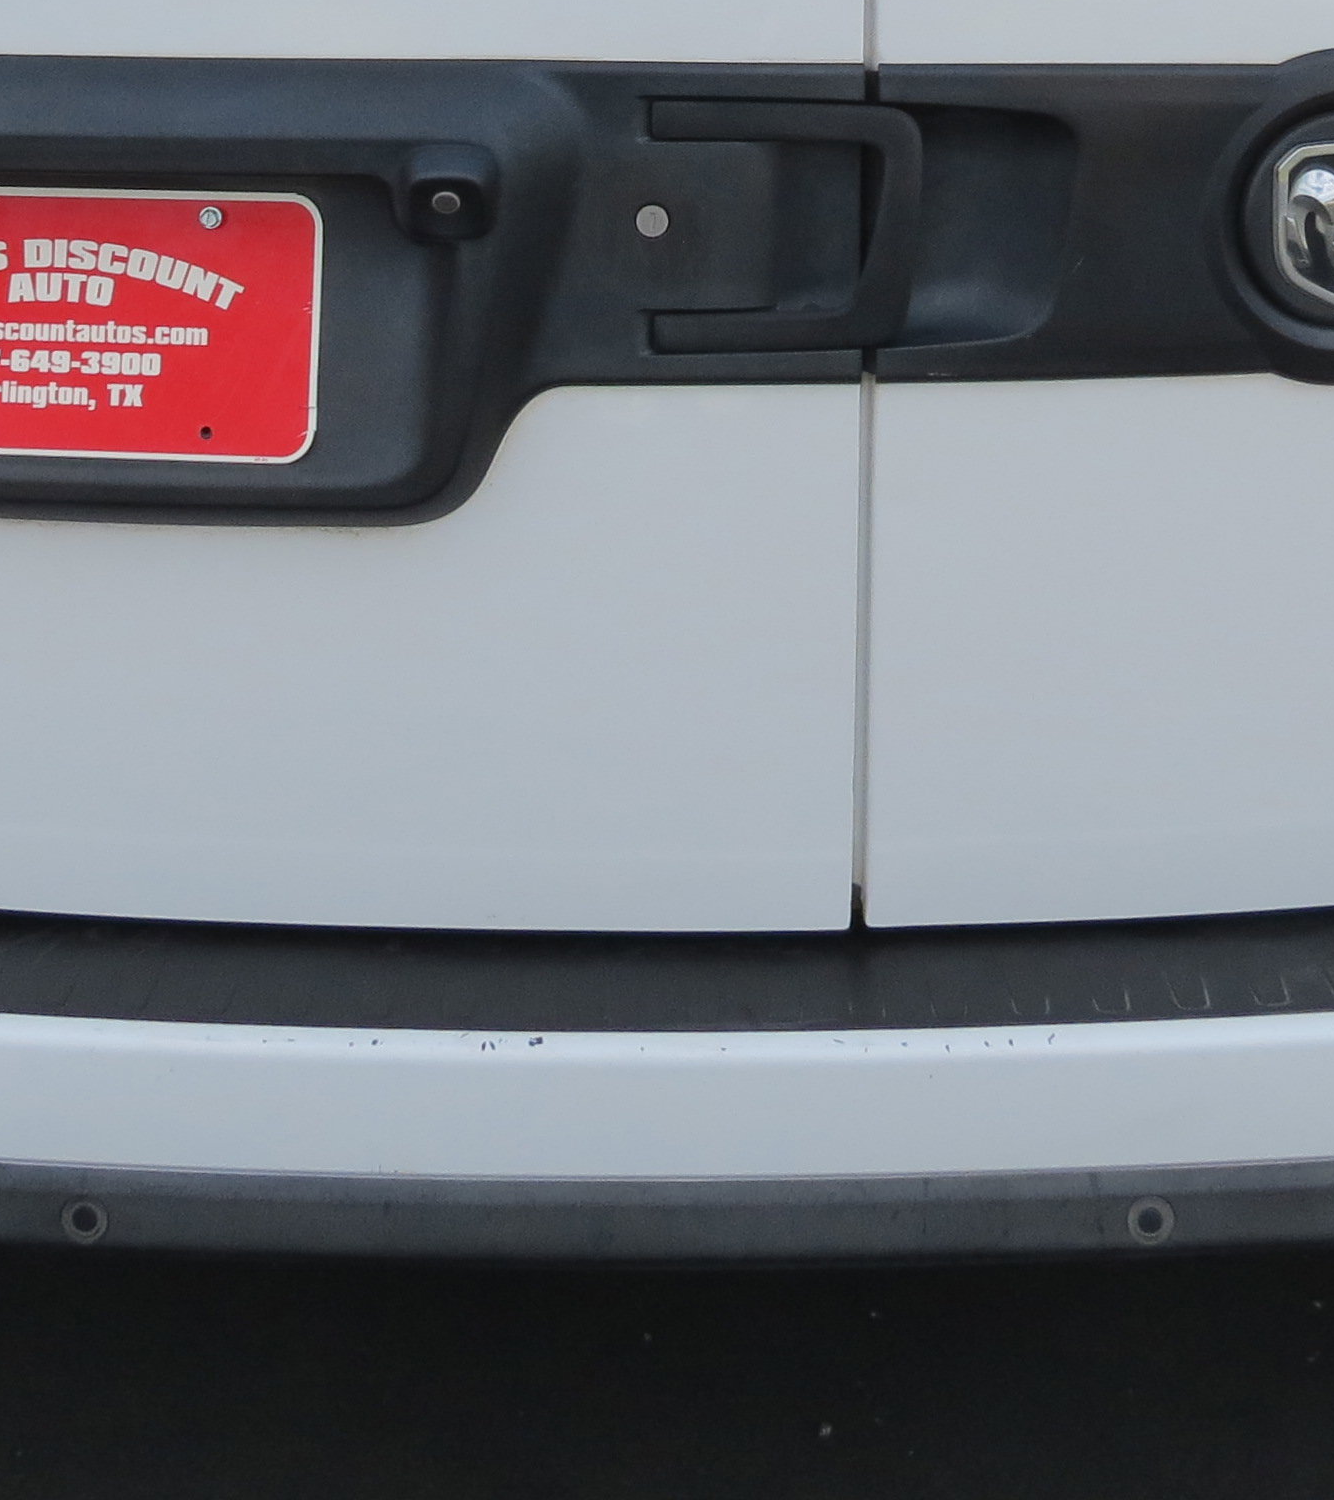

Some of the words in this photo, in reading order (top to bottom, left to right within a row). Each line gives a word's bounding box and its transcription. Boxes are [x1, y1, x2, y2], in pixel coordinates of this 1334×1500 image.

[8, 273, 115, 307] AUTO
[23, 238, 245, 311] DISCOUNT
[107, 383, 144, 408] TX
